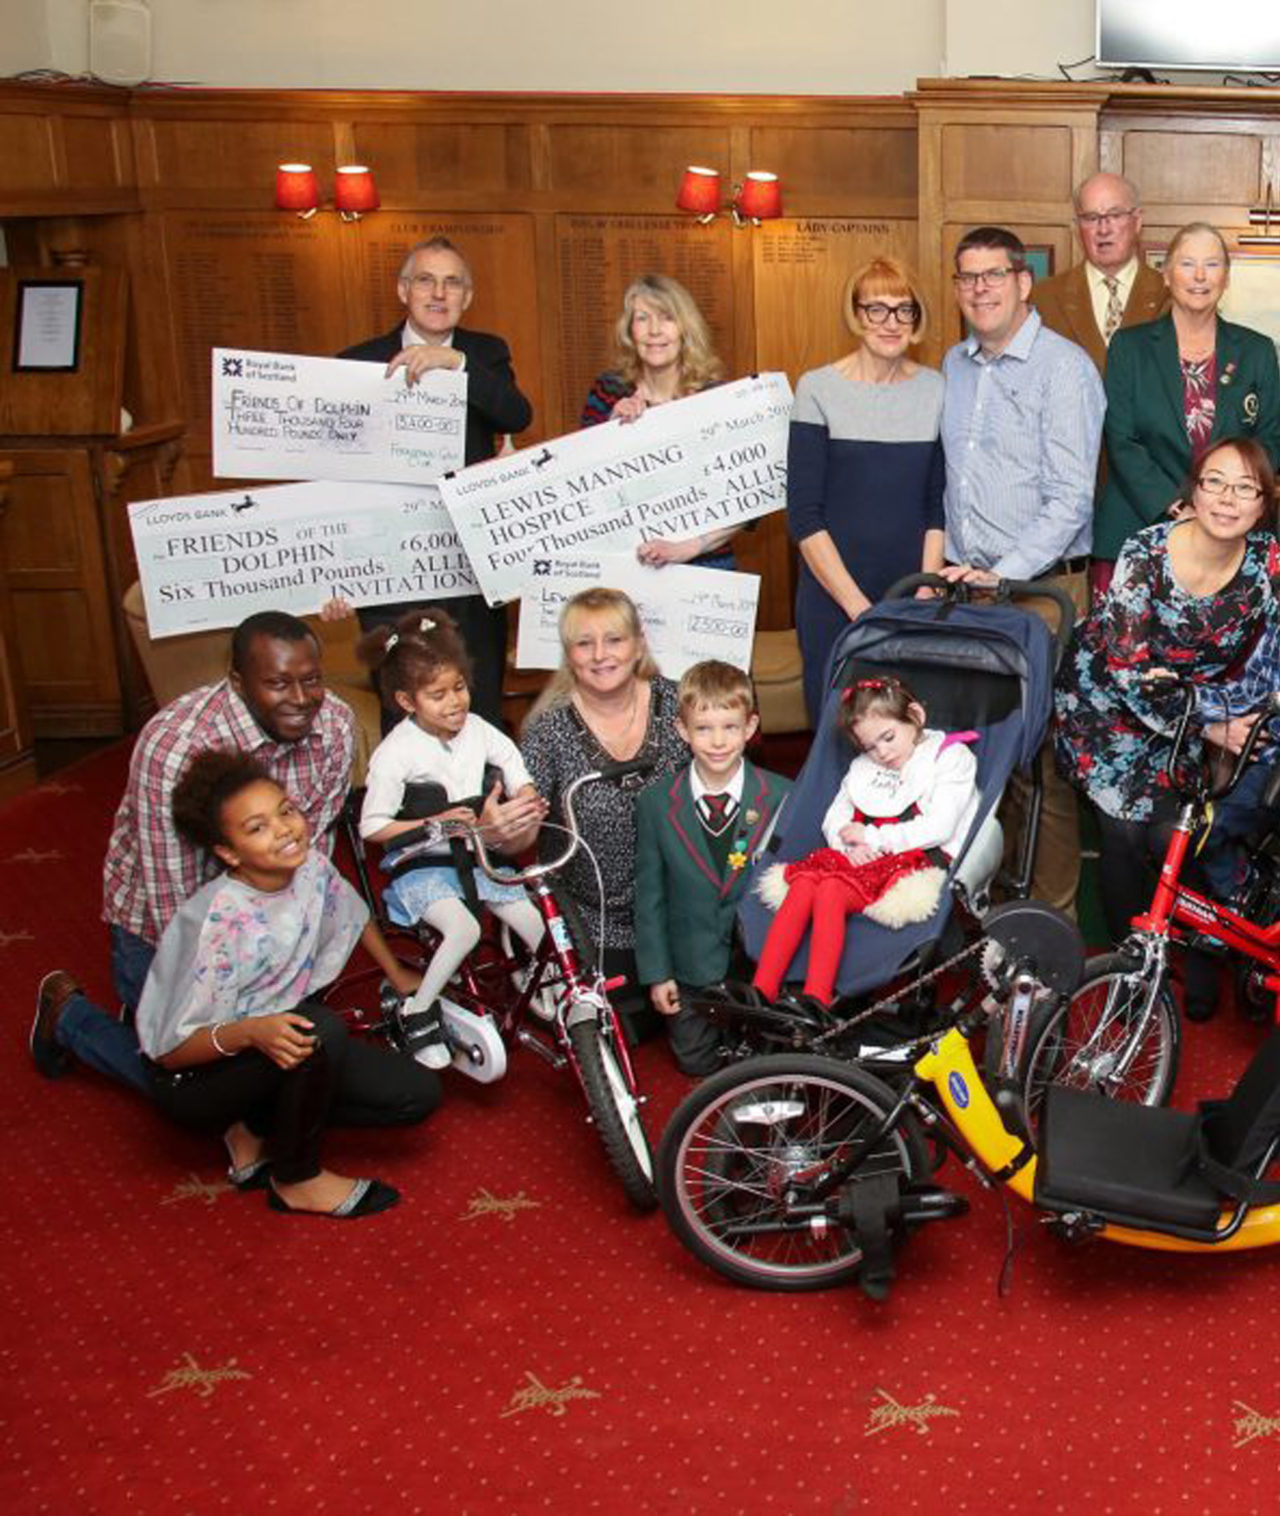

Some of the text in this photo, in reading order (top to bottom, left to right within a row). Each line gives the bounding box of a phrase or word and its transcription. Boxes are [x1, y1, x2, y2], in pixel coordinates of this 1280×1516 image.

[246, 359, 295, 371] Royal Bank
[457, 479, 498, 496] LLOYDS
[481, 444, 685, 525] LEWIS MANNING
[146, 512, 191, 526] LLOYDS
[488, 544, 535, 571] Four
[537, 511, 635, 553] Thousand
[637, 486, 709, 522] Pounds
[490, 500, 594, 546] HOSPICE
[167, 527, 279, 557] FRIENDS
[296, 525, 316, 540] OF
[320, 522, 349, 537] THE
[222, 541, 336, 575] DOLPHIN
[555, 560, 600, 569] Royal Bank
[159, 582, 195, 604] Six
[203, 572, 305, 599] Thousand
[312, 558, 386, 585] Pounds
